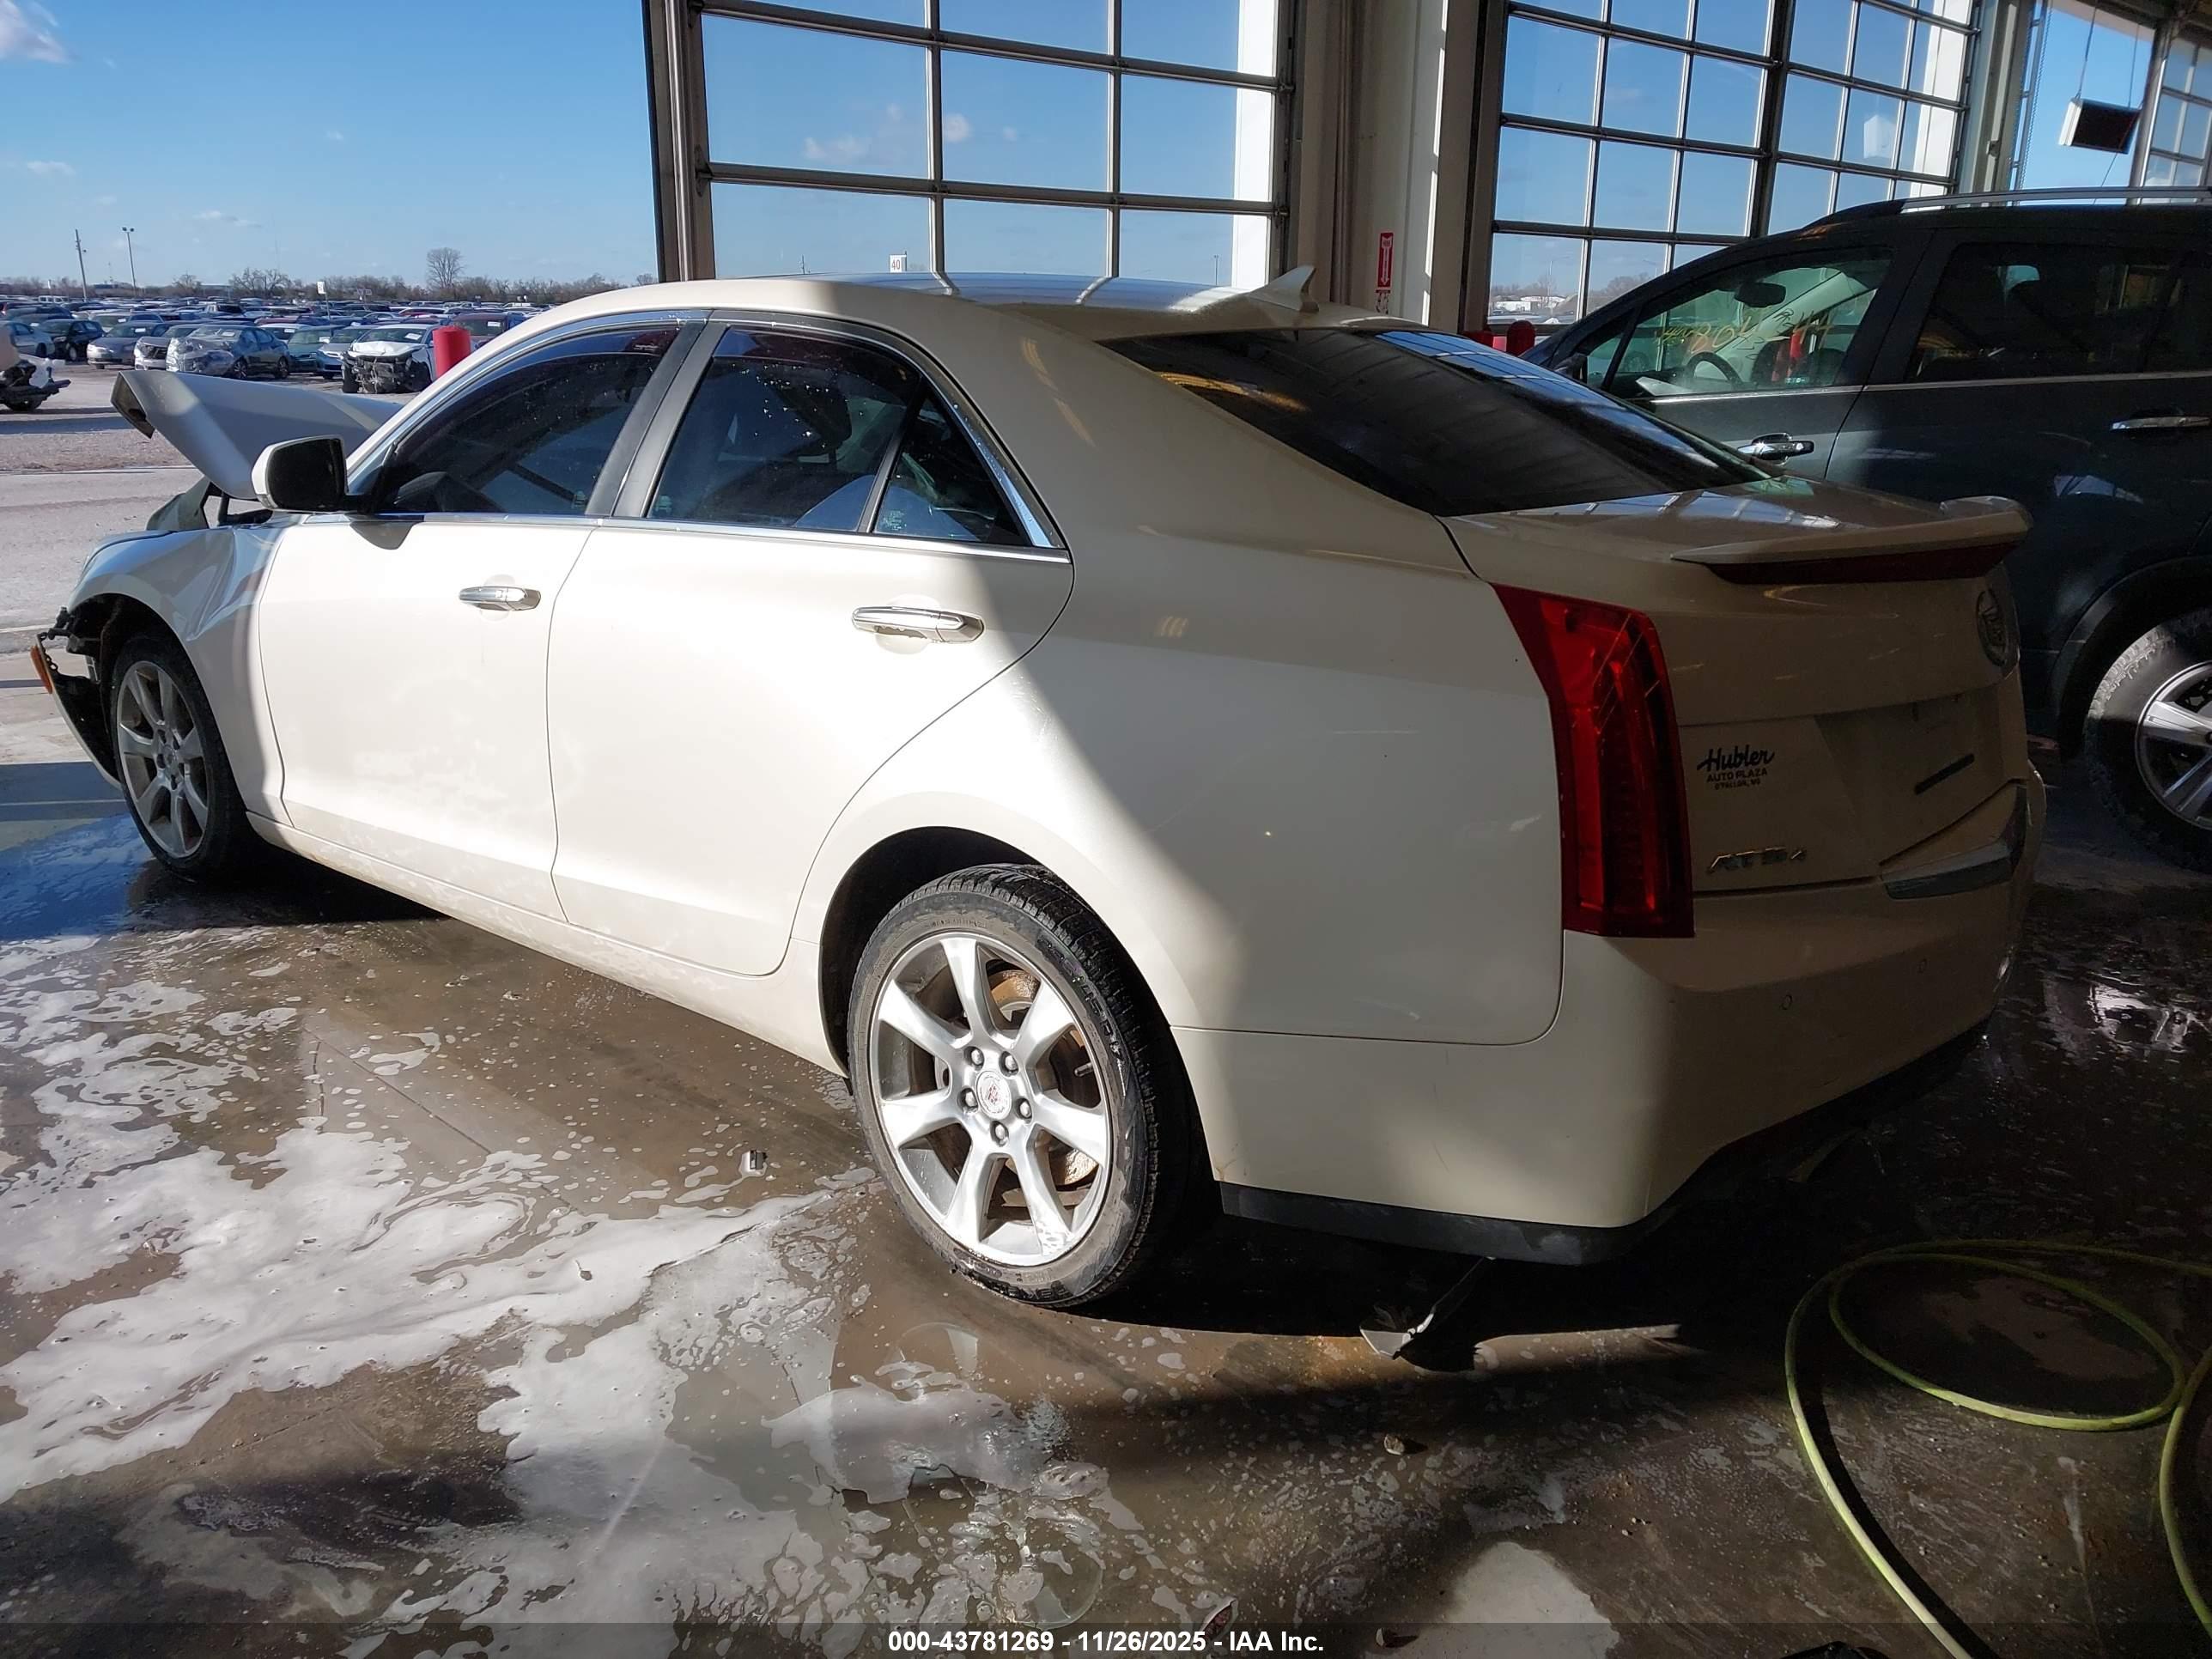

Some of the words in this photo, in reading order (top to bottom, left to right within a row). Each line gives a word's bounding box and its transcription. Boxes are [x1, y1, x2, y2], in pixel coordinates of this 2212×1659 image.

[891, 258, 901, 270] 40
[1697, 744, 1775, 772] Hubler
[1707, 772, 1734, 782] AUTO
[1735, 768, 1768, 780] PLAZA
